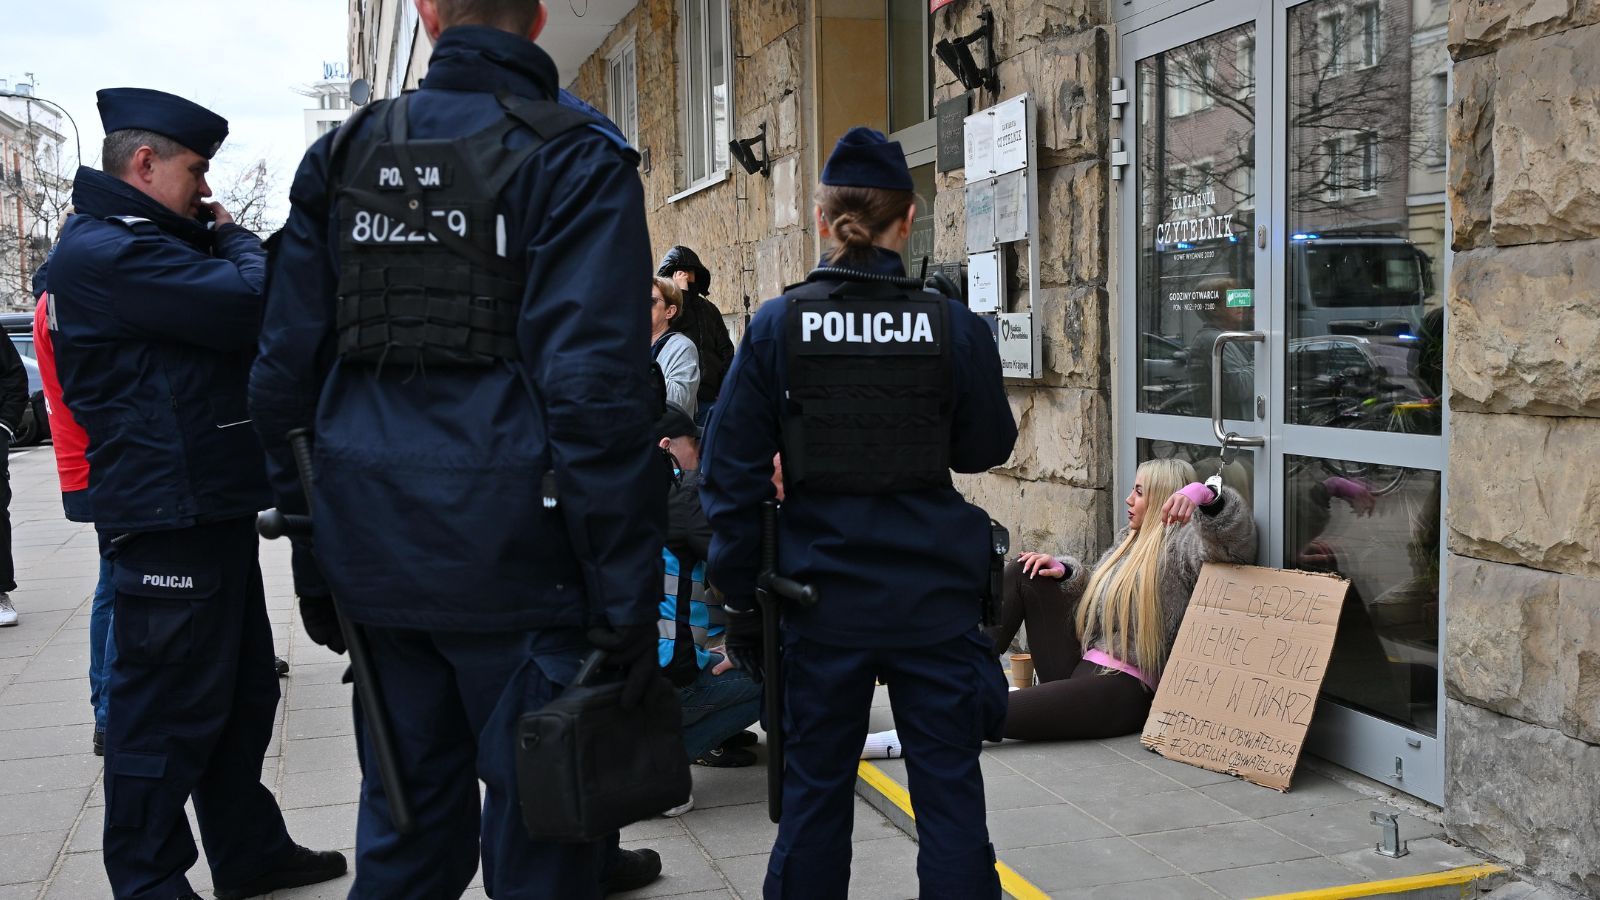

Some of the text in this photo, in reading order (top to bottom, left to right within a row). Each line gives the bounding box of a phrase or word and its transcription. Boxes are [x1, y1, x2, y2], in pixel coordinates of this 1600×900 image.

[379, 167, 440, 186] POCJA
[1172, 191, 1216, 210] KAWIARNIA
[1157, 214, 1234, 244] CZYTELNIK
[1169, 290, 1220, 301] GODZINY OTWARCIA
[802, 311, 934, 343] POLICJA
[142, 574, 193, 589] POLICJA
[1195, 577, 1329, 630] NIE BĘDZIE
[1183, 621, 1258, 666] NIEMIEC
[1165, 660, 1312, 727] NAM W TWARZ
[1229, 728, 1297, 758] OBYWATELSKA
[1228, 751, 1293, 779] OBYWATELSKA
